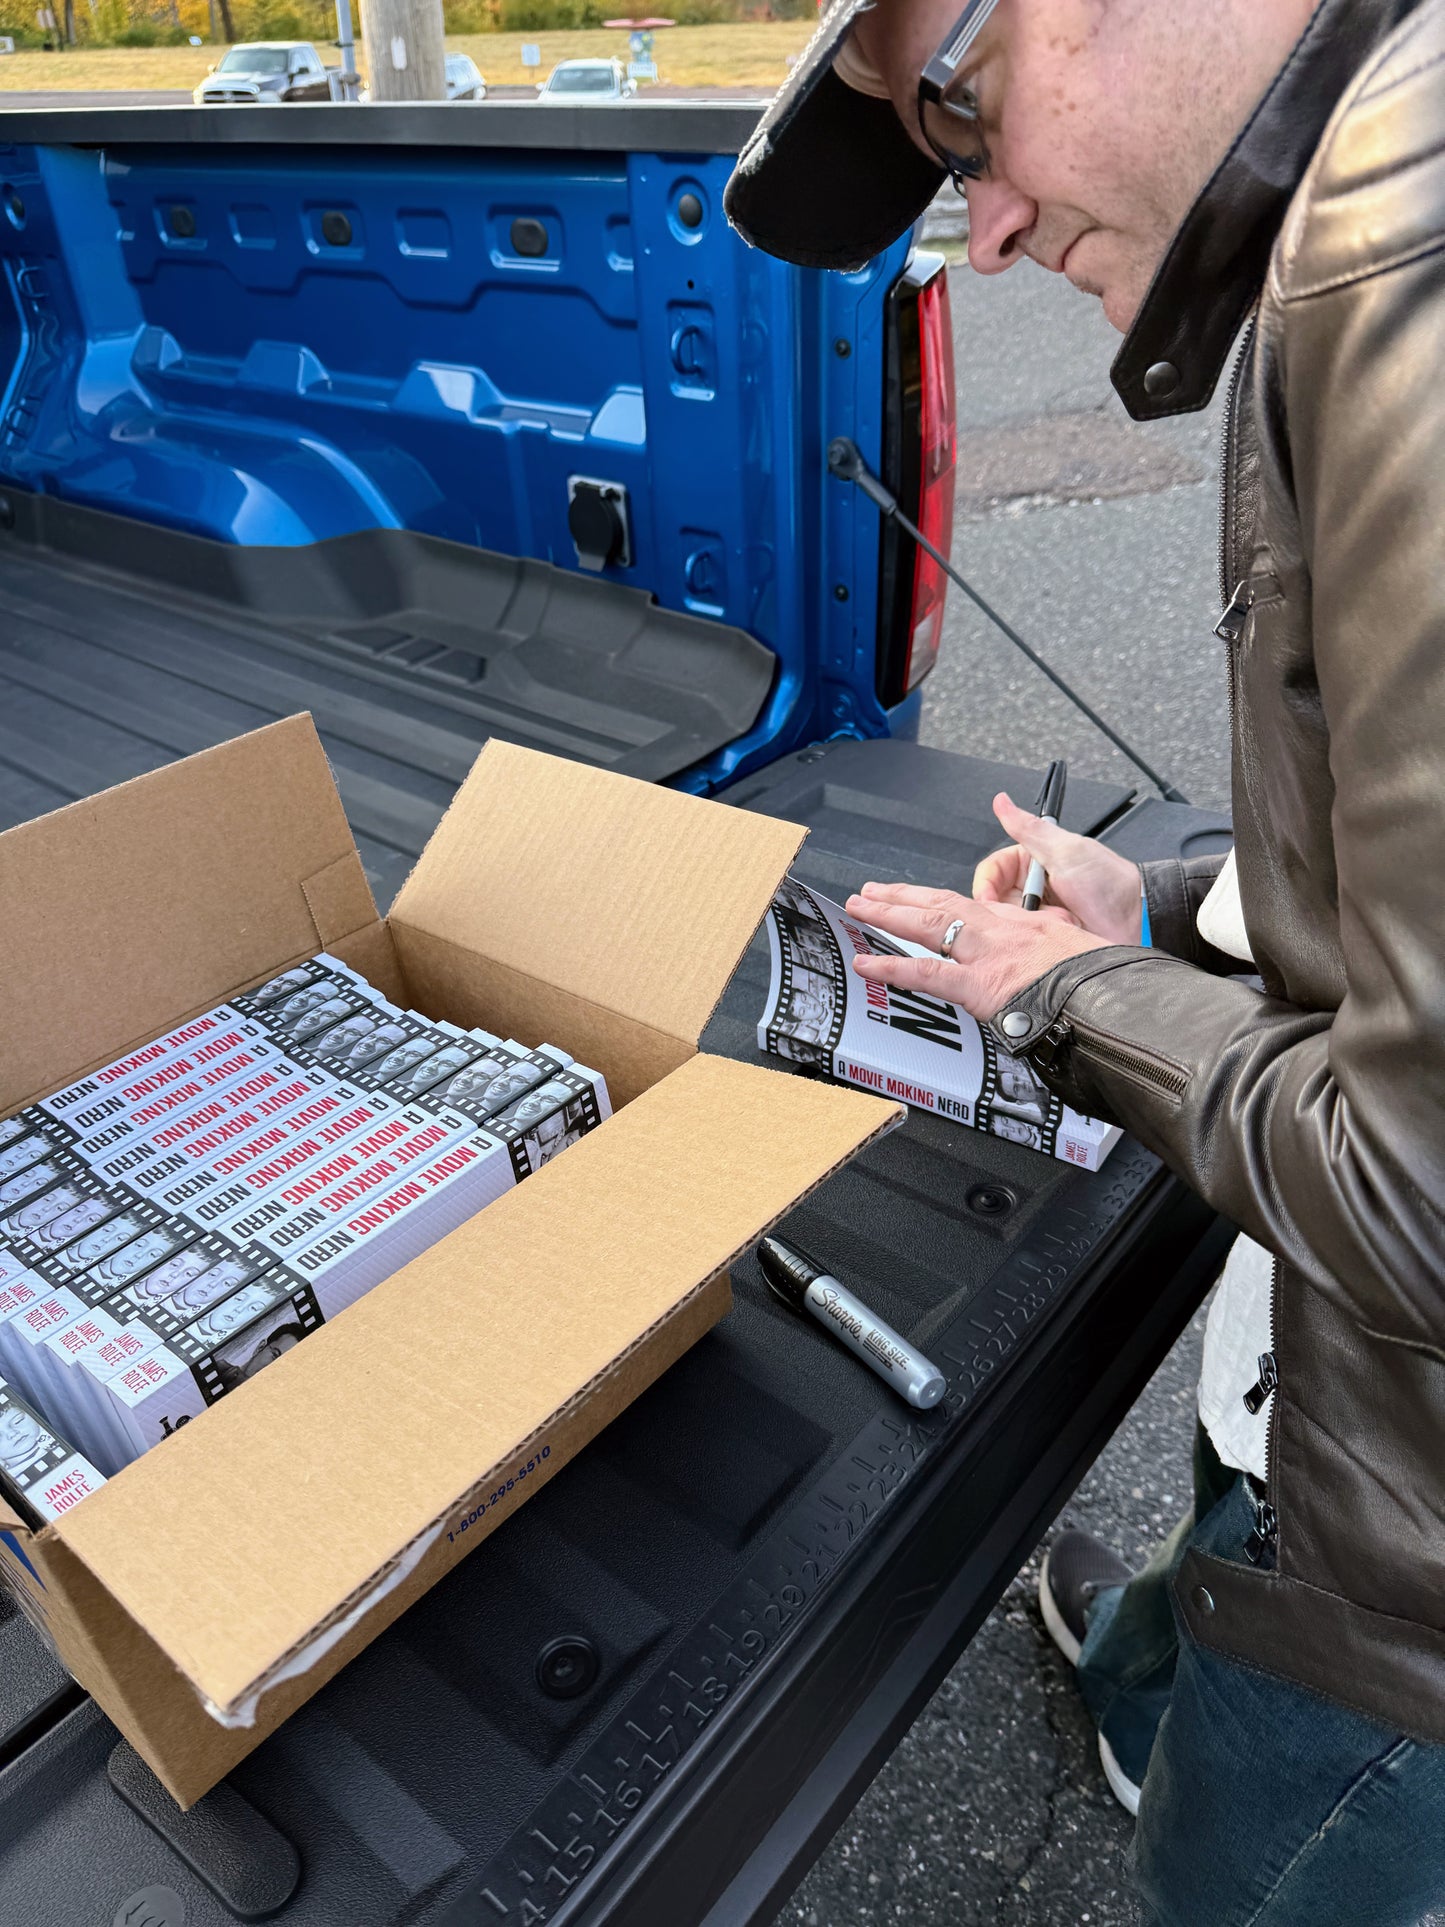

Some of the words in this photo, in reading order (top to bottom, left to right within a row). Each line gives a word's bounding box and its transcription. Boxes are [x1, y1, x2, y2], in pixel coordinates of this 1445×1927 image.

[214, 1010, 232, 1021] A
[240, 1024, 259, 1036] A
[866, 1010, 888, 1024] A
[164, 1018, 218, 1048] MOVIE
[189, 1031, 245, 1064] MOVIE
[250, 1044, 270, 1056] A
[97, 1044, 168, 1084] MAKING
[122, 1059, 194, 1102] MAKING
[199, 1052, 256, 1086] MOVIE
[273, 1063, 294, 1076] A
[305, 1072, 326, 1086] A
[50, 1080, 100, 1110] NERD
[130, 1081, 204, 1126] MAKING
[221, 1072, 280, 1108] MOVIE
[253, 1080, 312, 1116] MOVIE
[334, 1087, 355, 1100] A
[368, 1098, 389, 1111] A
[838, 1060, 845, 1076] A
[849, 1064, 884, 1090] MOVIE
[887, 1078, 934, 1108] MAKING
[938, 1096, 970, 1120] NERD
[74, 1096, 126, 1128] NERD
[152, 1102, 228, 1148] MAKING
[282, 1096, 341, 1132] MOVIE
[316, 1106, 374, 1144] MOVIE
[402, 1111, 424, 1124] A
[439, 1115, 462, 1130] A
[82, 1121, 134, 1154] NERD
[183, 1111, 260, 1158] MAKING
[212, 1128, 289, 1175] MAKING
[351, 1120, 410, 1159] MOVIE
[389, 1125, 448, 1165] MOVIE
[469, 1136, 492, 1150] A
[1065, 1140, 1077, 1161] JAMES
[103, 1142, 156, 1178] NERD
[134, 1152, 189, 1188] NERD
[245, 1139, 323, 1189] MAKING
[418, 1146, 478, 1186] MOVIE
[163, 1170, 218, 1206] NERD
[280, 1154, 359, 1205] MAKING
[318, 1160, 397, 1213] MAKING
[195, 1183, 252, 1221] NERD
[346, 1181, 427, 1235] MAKING
[230, 1200, 288, 1239] NERD
[269, 1207, 327, 1247] NERD
[296, 1230, 355, 1270] NERD
[8, 1282, 36, 1304] JAMES
[23, 1308, 52, 1332] ROLFE
[40, 1299, 69, 1322] JAMES
[58, 1330, 87, 1354] ROLFE
[75, 1320, 105, 1344] JAMES
[113, 1332, 143, 1356] JAMES
[867, 1329, 890, 1350] KING
[97, 1343, 126, 1367] ROLFE
[137, 1358, 168, 1383] JAMES
[120, 1369, 150, 1394] ROLFE
[44, 1469, 84, 1505] JAMES
[53, 1480, 94, 1513] ROLFE
[447, 1446, 551, 1542] 1-800-295-5510
[544, 1836, 595, 1896] 15
[592, 1780, 642, 1838] 16
[637, 1725, 681, 1780] 17
[683, 1677, 728, 1727] 18
[725, 1630, 766, 1677] 19
[764, 1585, 806, 1630] 20
[868, 1462, 907, 1501] 23
[959, 1354, 994, 1389] 26
[986, 1321, 1017, 1355] 27
[1012, 1292, 1045, 1323] 28
